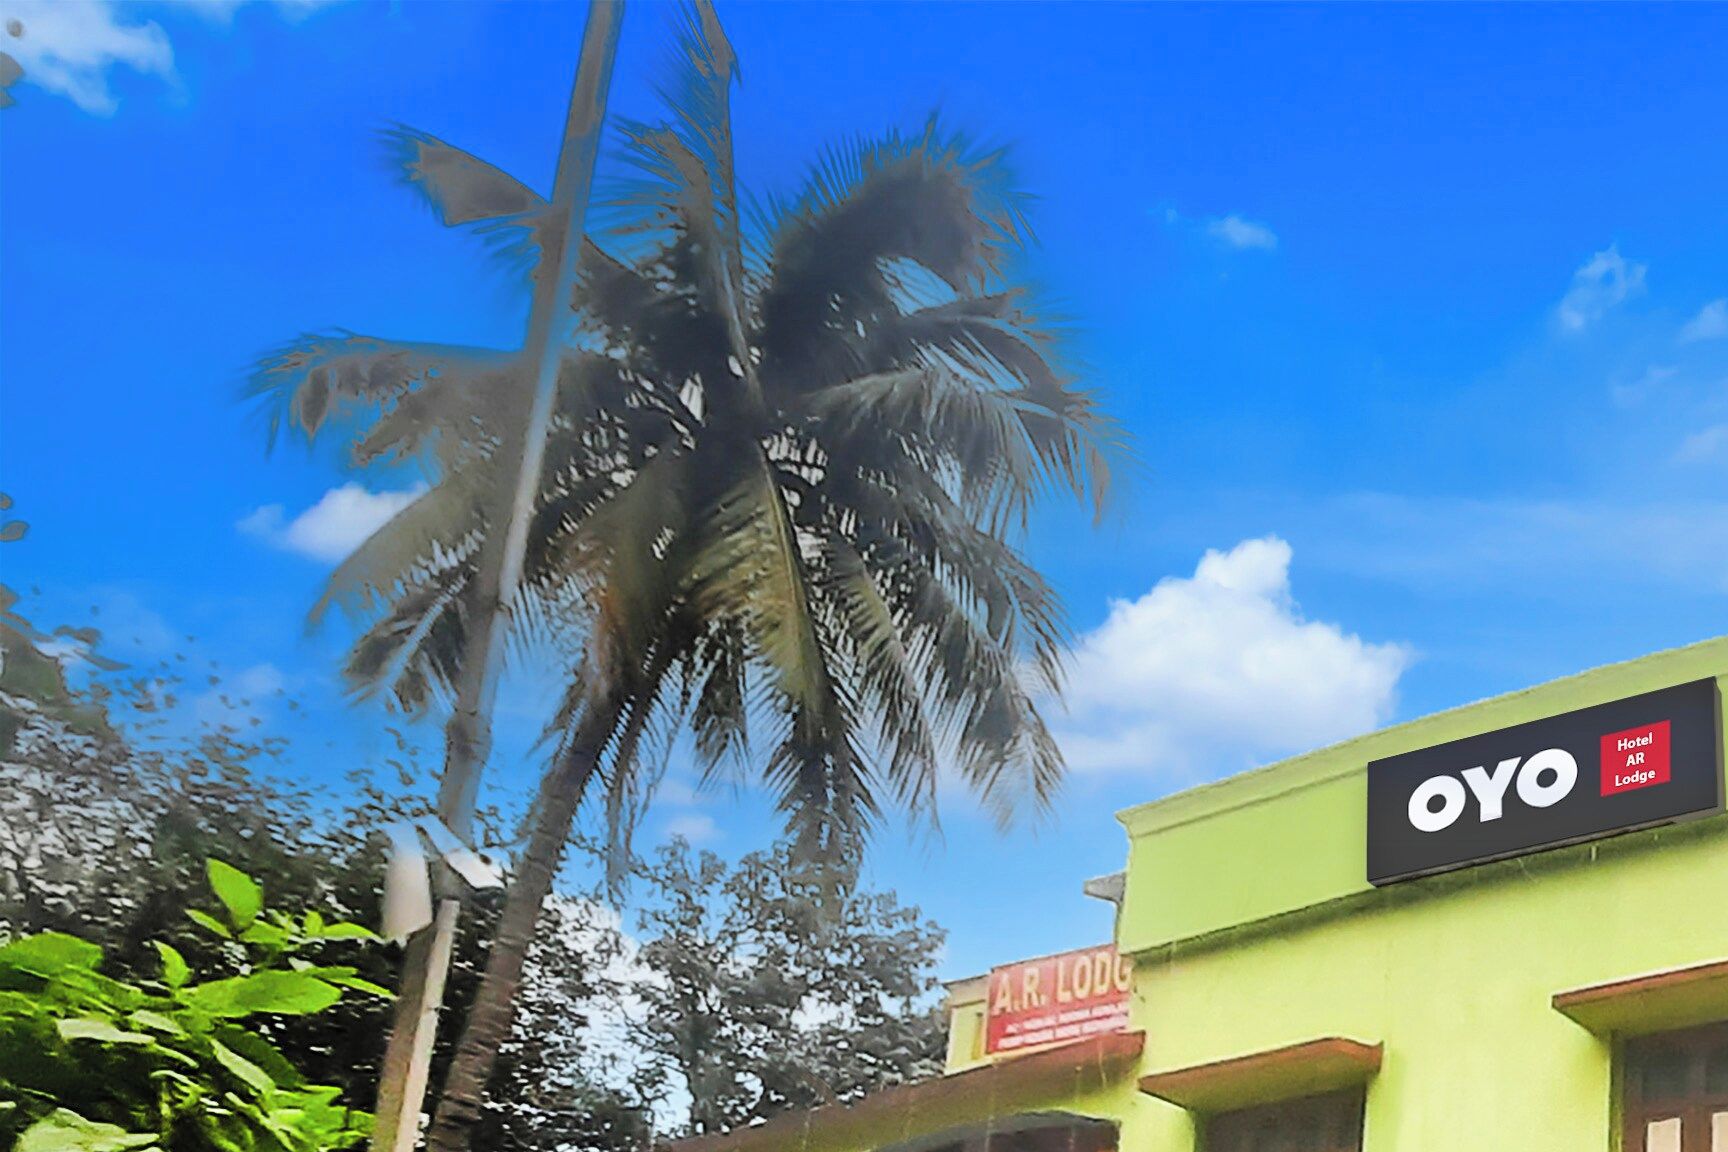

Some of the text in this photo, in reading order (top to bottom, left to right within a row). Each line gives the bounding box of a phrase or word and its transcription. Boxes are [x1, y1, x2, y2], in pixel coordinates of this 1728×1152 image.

[1617, 731, 1653, 752] Hotel
[1625, 751, 1645, 767] AR
[1614, 769, 1656, 787] Lodge
[1407, 748, 1578, 833] OYO
